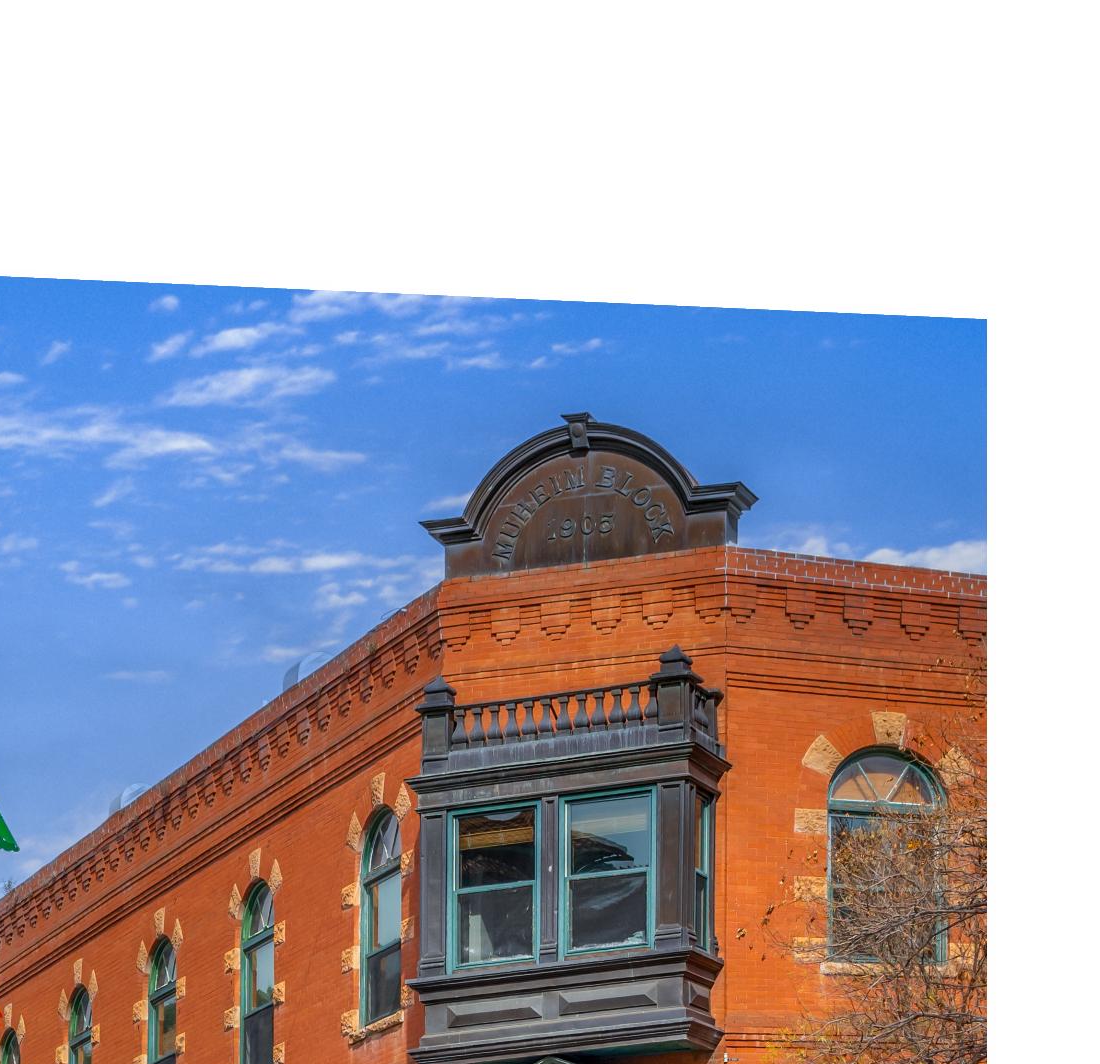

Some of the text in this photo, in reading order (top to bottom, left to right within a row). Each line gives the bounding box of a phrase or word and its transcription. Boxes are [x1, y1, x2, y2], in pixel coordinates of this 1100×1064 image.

[491, 465, 675, 561] MUHEIM BLOCK
[547, 512, 615, 541] 1905
